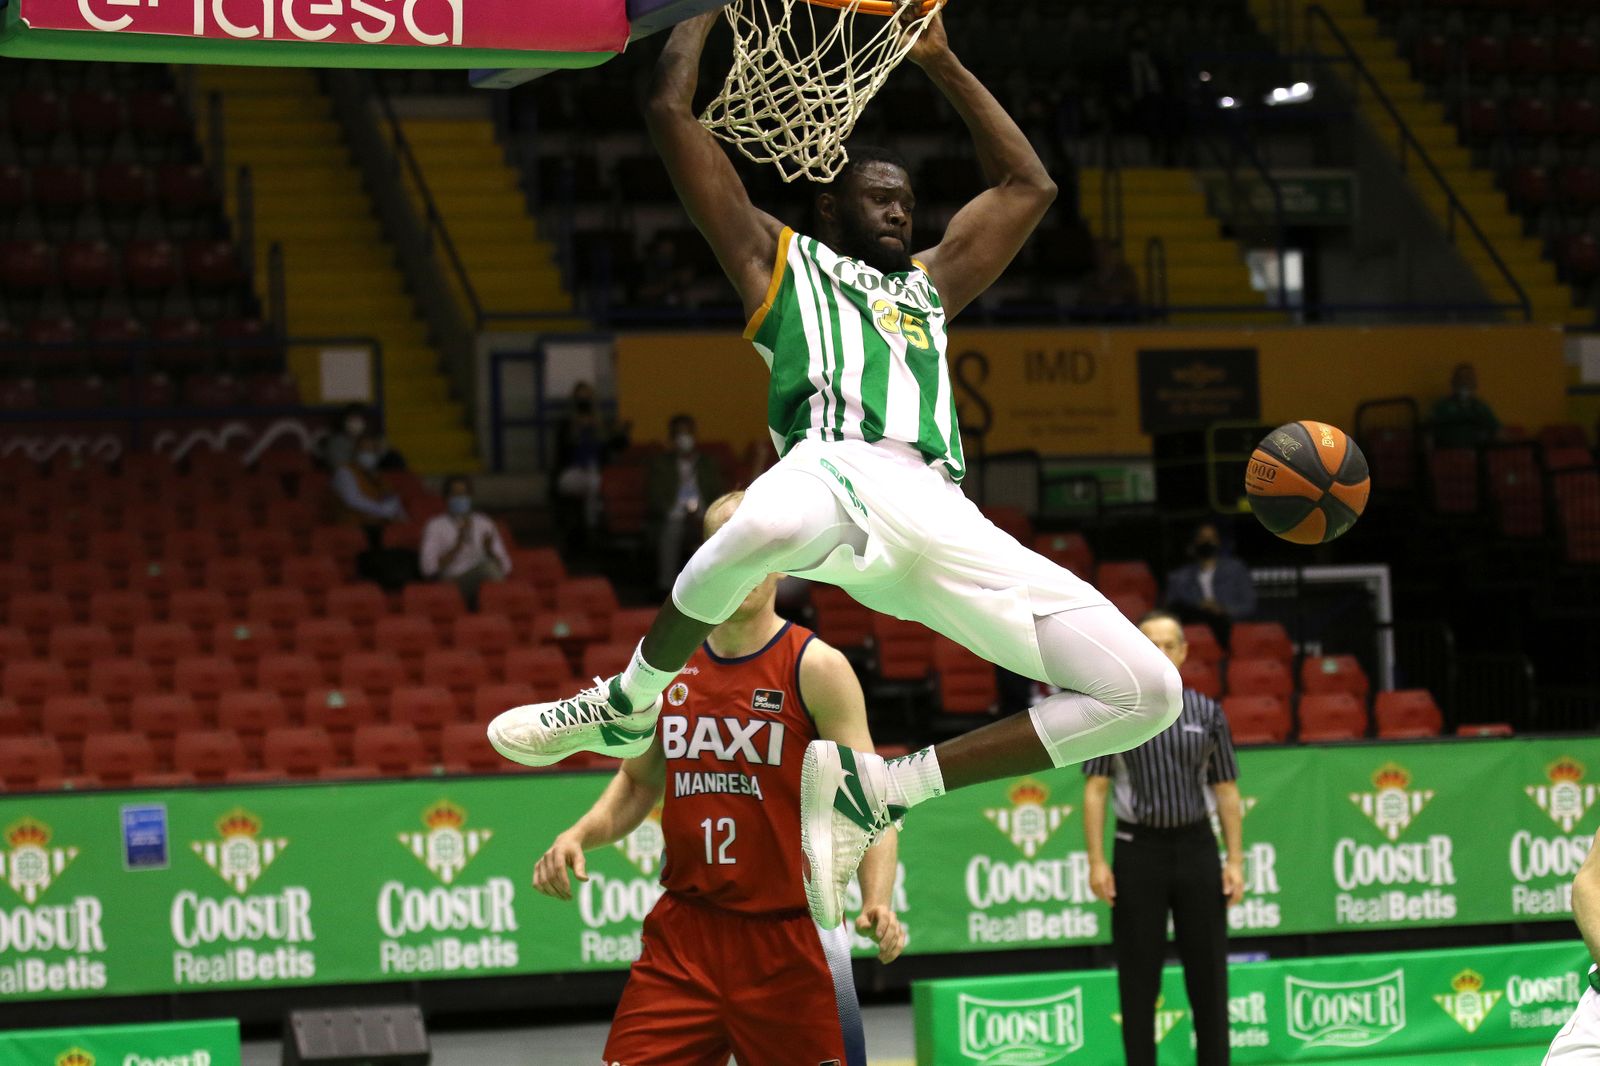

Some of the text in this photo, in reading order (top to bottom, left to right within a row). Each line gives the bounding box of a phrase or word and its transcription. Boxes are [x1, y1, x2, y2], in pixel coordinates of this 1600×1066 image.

[872, 298, 929, 350] 35
[754, 702, 780, 710] endesa
[662, 715, 785, 766] BAXI
[674, 772, 764, 801] MANRESA
[701, 817, 737, 865] 12
[1510, 830, 1595, 883] COOS
